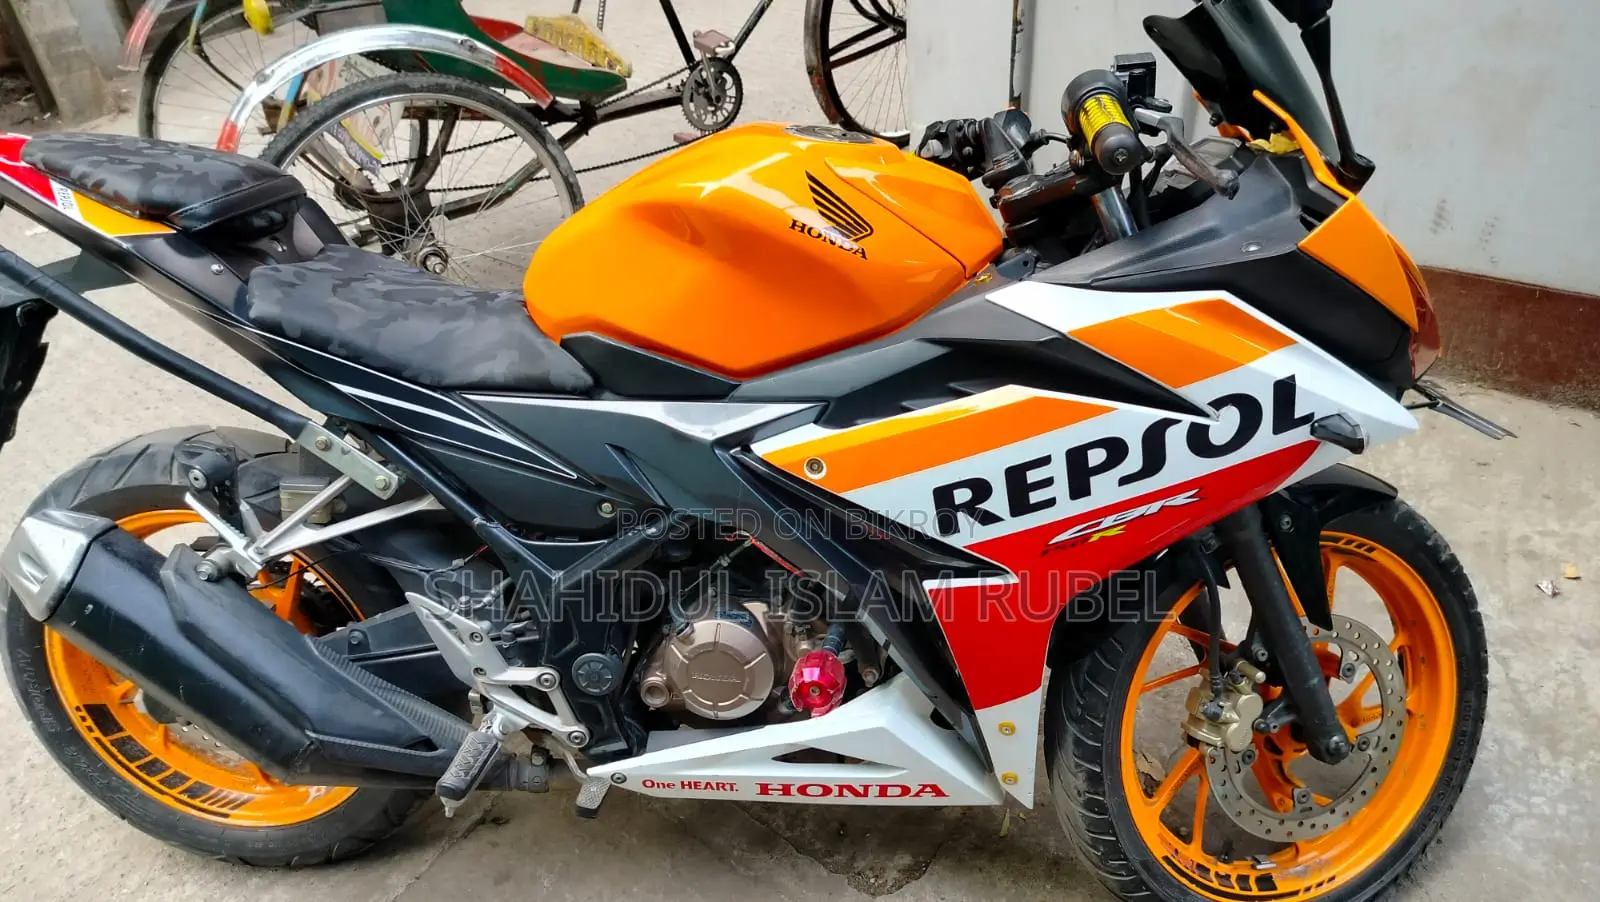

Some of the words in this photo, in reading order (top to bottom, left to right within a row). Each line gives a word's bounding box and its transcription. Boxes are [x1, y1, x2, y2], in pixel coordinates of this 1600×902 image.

[789, 219, 868, 260] HONDA
[932, 374, 1316, 536] REPSOL
[641, 778, 677, 790] One
[680, 780, 741, 793] HEART.
[755, 782, 950, 798] HONDA
